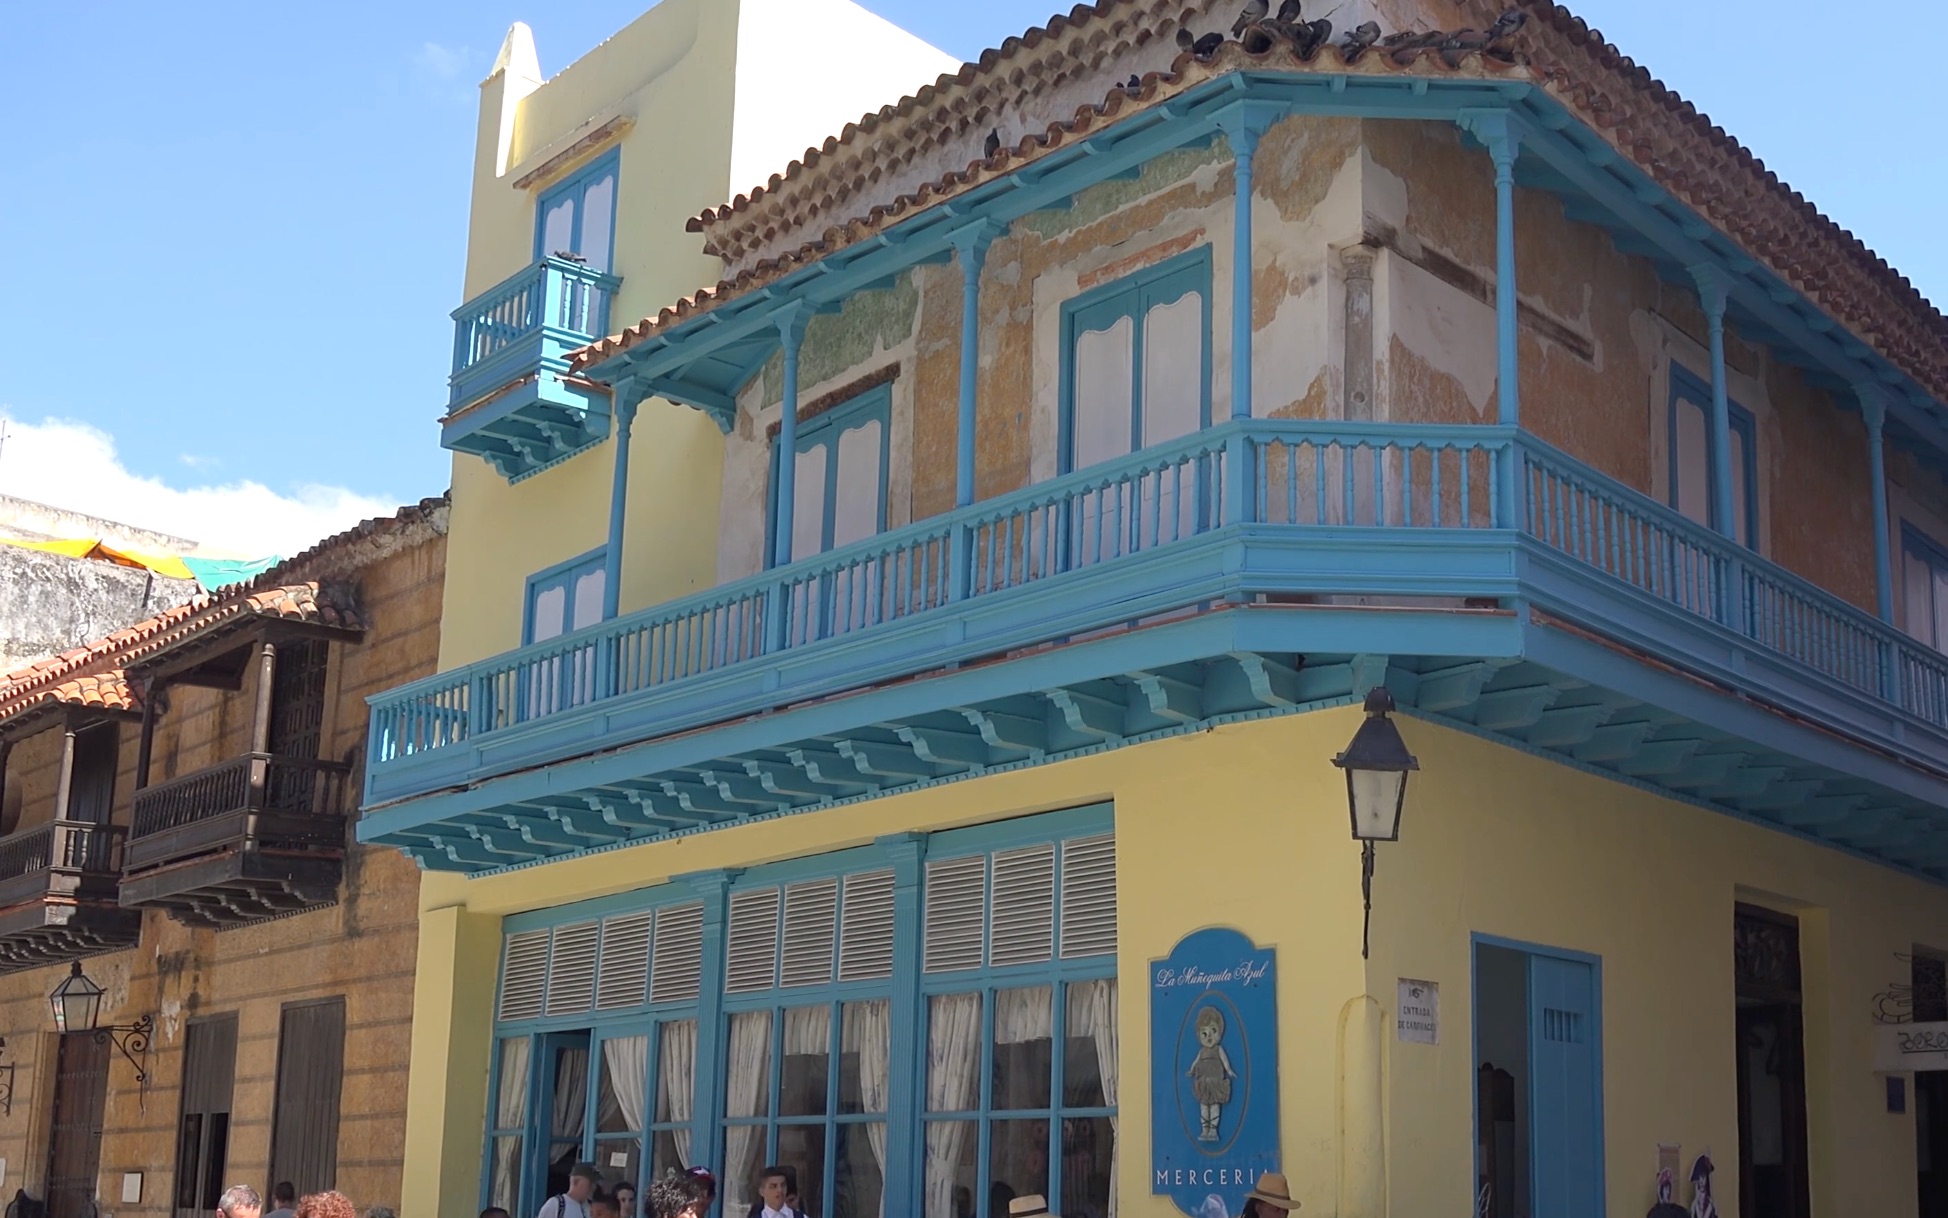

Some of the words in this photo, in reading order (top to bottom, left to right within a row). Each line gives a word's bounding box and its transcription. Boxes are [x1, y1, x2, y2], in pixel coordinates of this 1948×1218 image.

[1155, 968, 1176, 988] La
[1177, 965, 1232, 990] Muñequita
[1233, 960, 1269, 987] Azul
[1403, 1006, 1431, 1017] ENTRADA
[1398, 1020, 1405, 1030] DE
[1157, 1168, 1269, 1185] MERCERI
